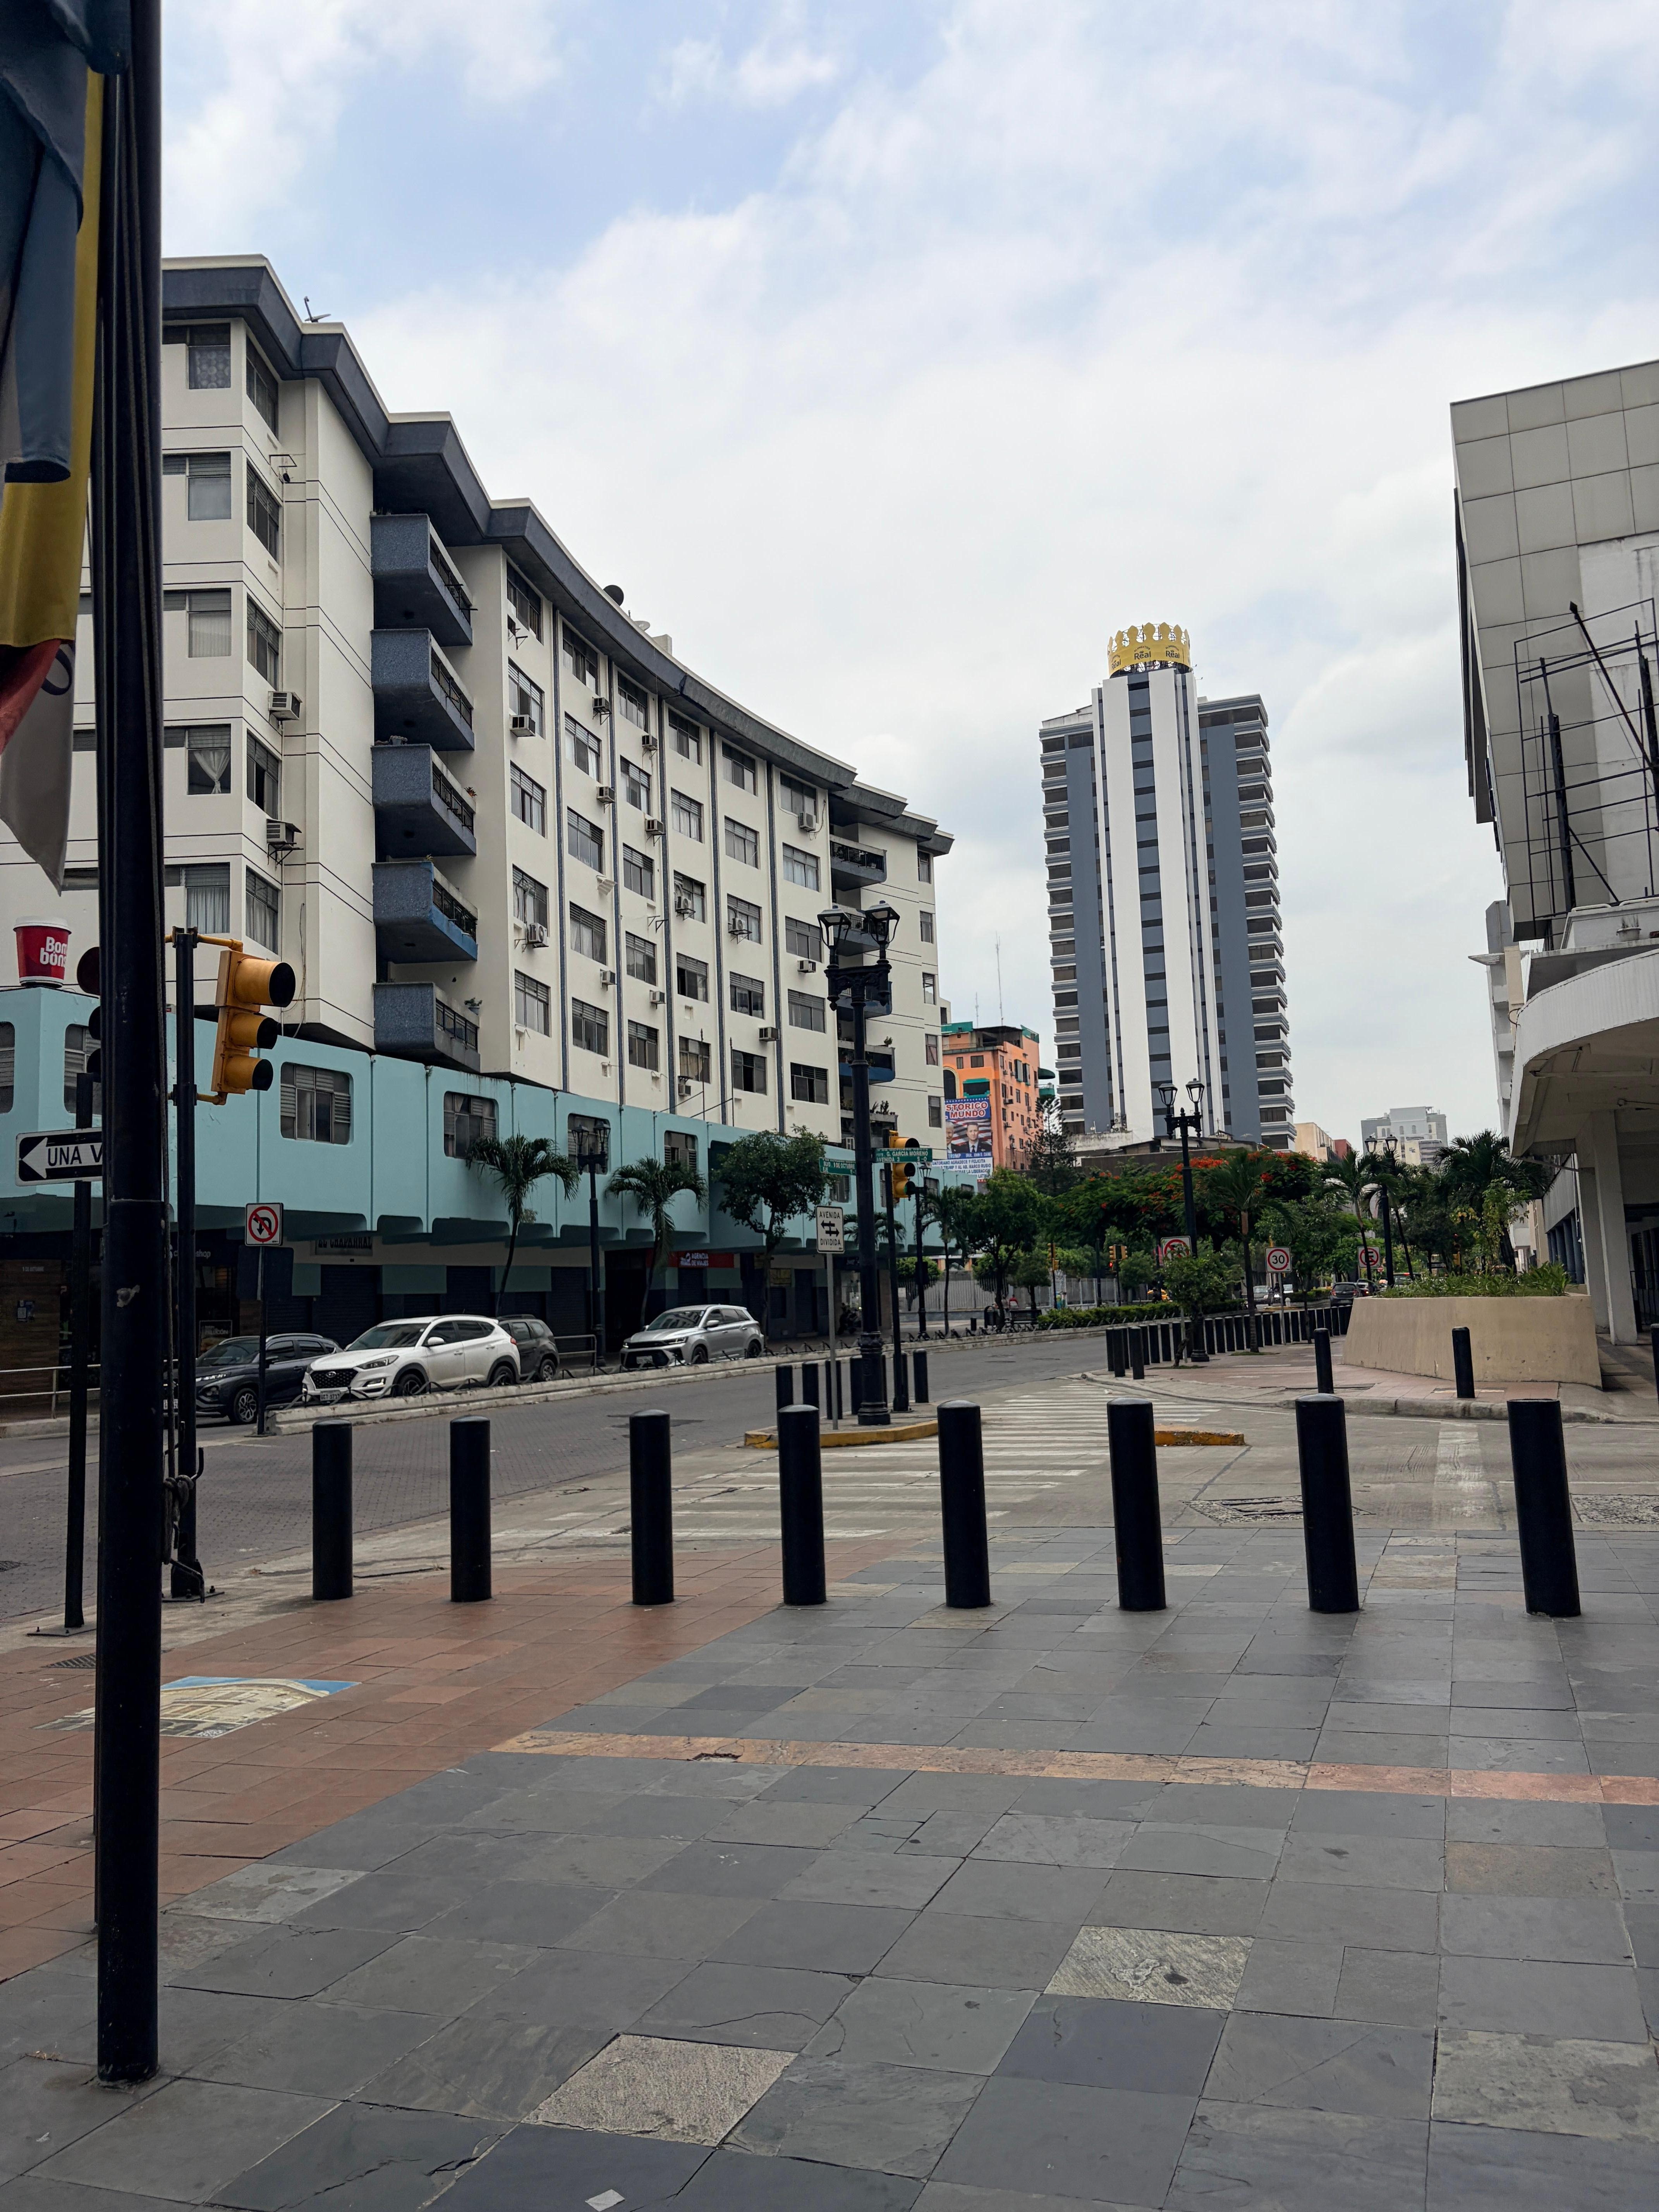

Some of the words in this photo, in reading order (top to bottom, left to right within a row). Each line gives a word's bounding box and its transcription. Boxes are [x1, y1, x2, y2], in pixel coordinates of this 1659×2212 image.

[1134, 651, 1151, 660] Real
[1166, 650, 1180, 658] Real
[945, 1101, 988, 1111] STORICO
[950, 1109, 986, 1118] MUNDO
[48, 1146, 82, 1167] UNA
[819, 1211, 840, 1219] AVENIDA
[196, 1249, 211, 1259] shop
[1272, 1255, 1285, 1264] 30
